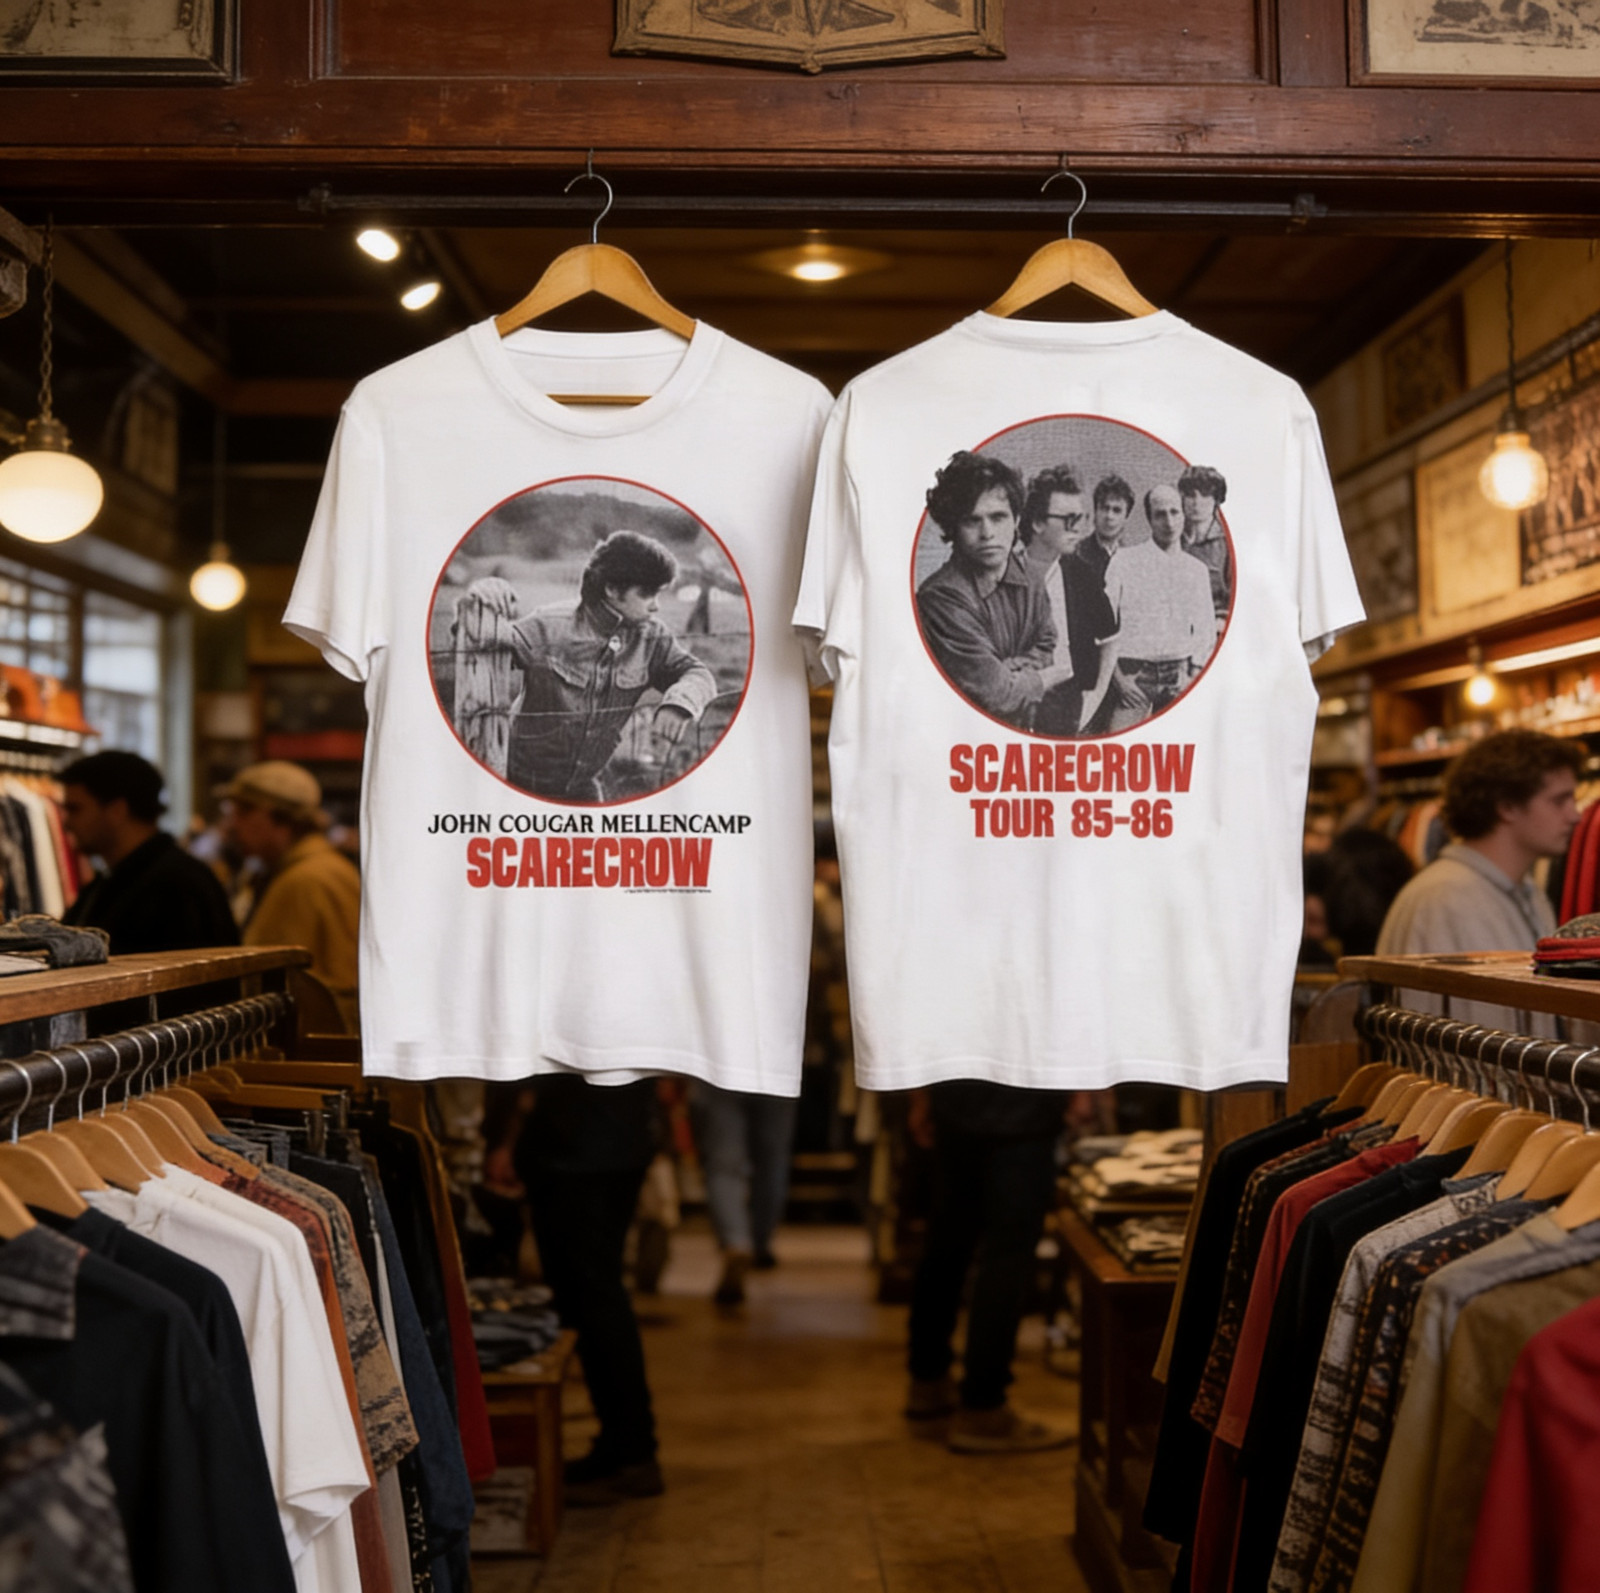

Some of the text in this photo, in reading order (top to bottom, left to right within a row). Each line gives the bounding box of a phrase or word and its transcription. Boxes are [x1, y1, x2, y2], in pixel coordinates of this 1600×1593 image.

[949, 743, 1195, 793] SCARECROW
[427, 813, 752, 834] JOHN COUGAR MELLENCAMP
[969, 798, 1174, 838] TOUR 85-86
[466, 837, 713, 888] SCARECROW
